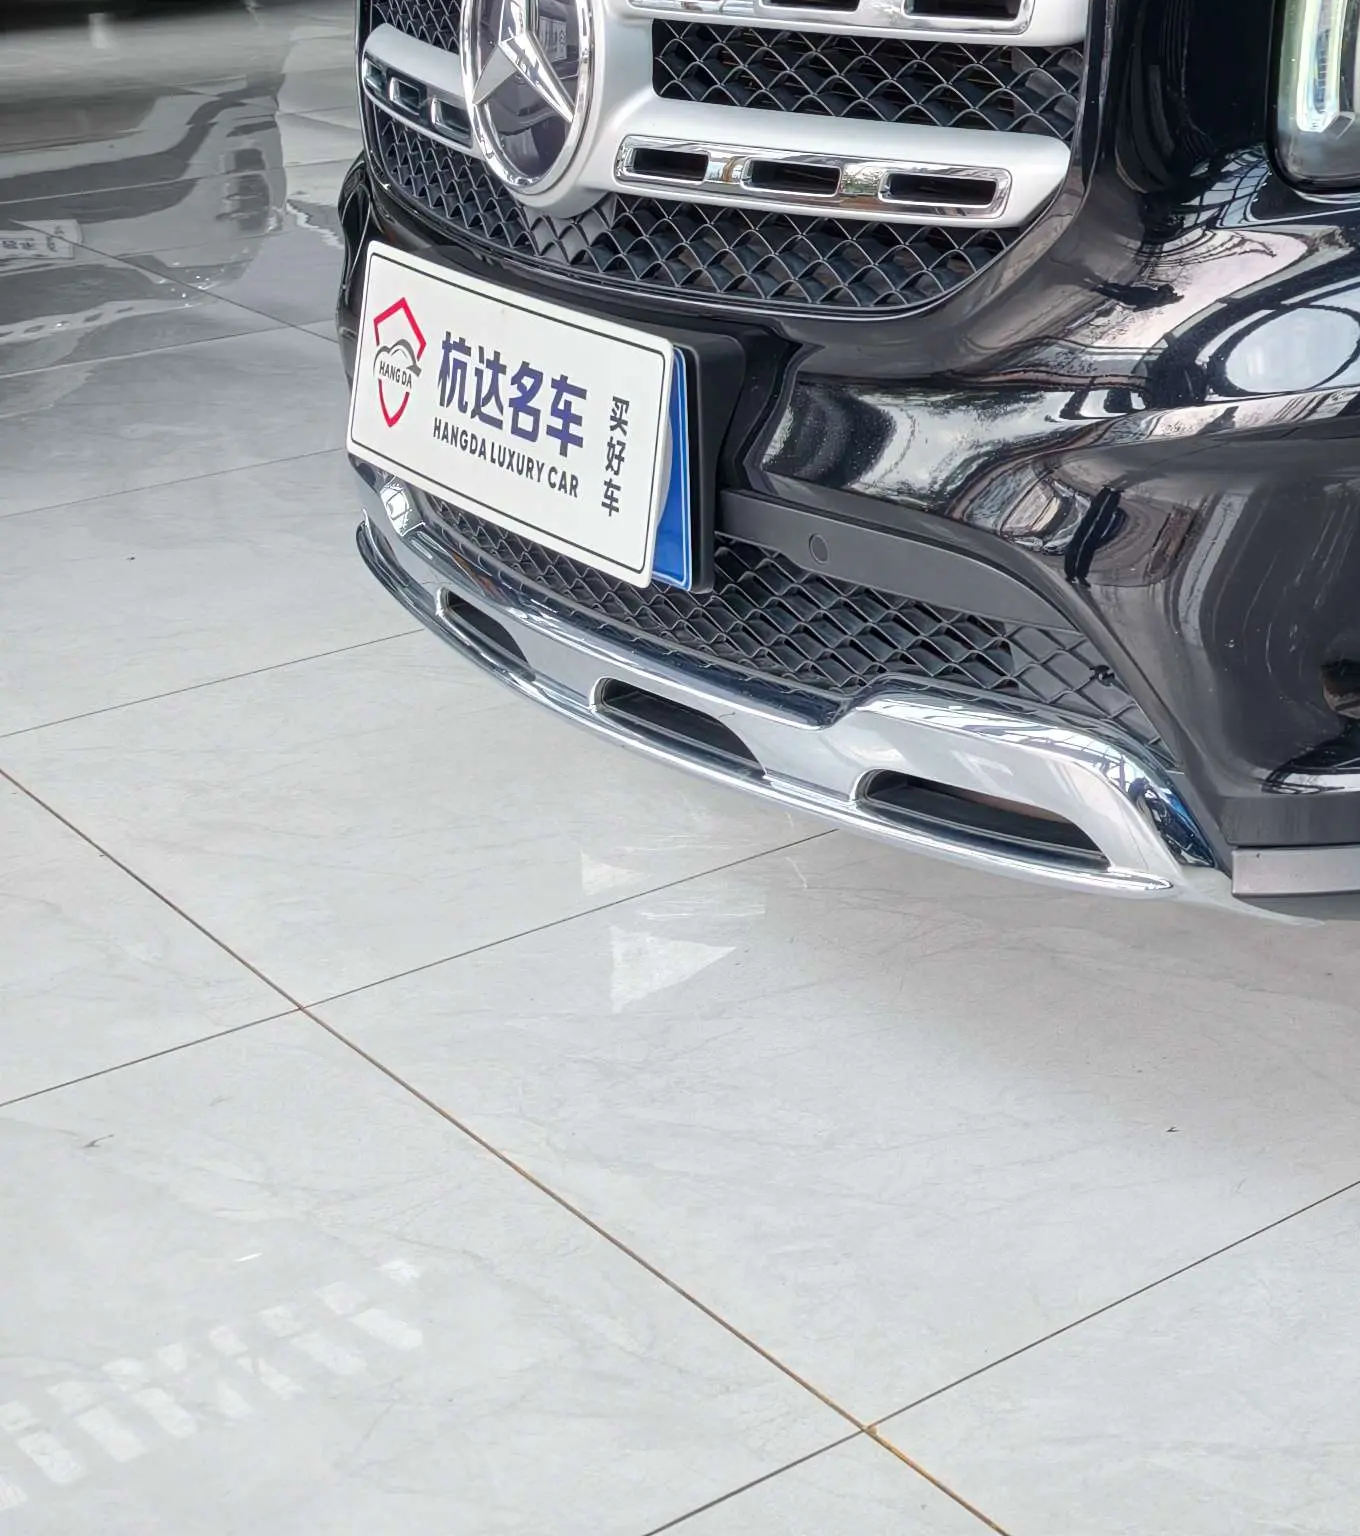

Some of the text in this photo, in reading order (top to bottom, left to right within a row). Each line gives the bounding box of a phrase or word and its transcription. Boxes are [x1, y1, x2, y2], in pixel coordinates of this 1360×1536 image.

[378, 360, 413, 390] HANG DA
[438, 331, 588, 458] 杭达名车
[433, 416, 580, 499] HANGDA LUXURY CAR
[600, 395, 631, 518] 买好车
